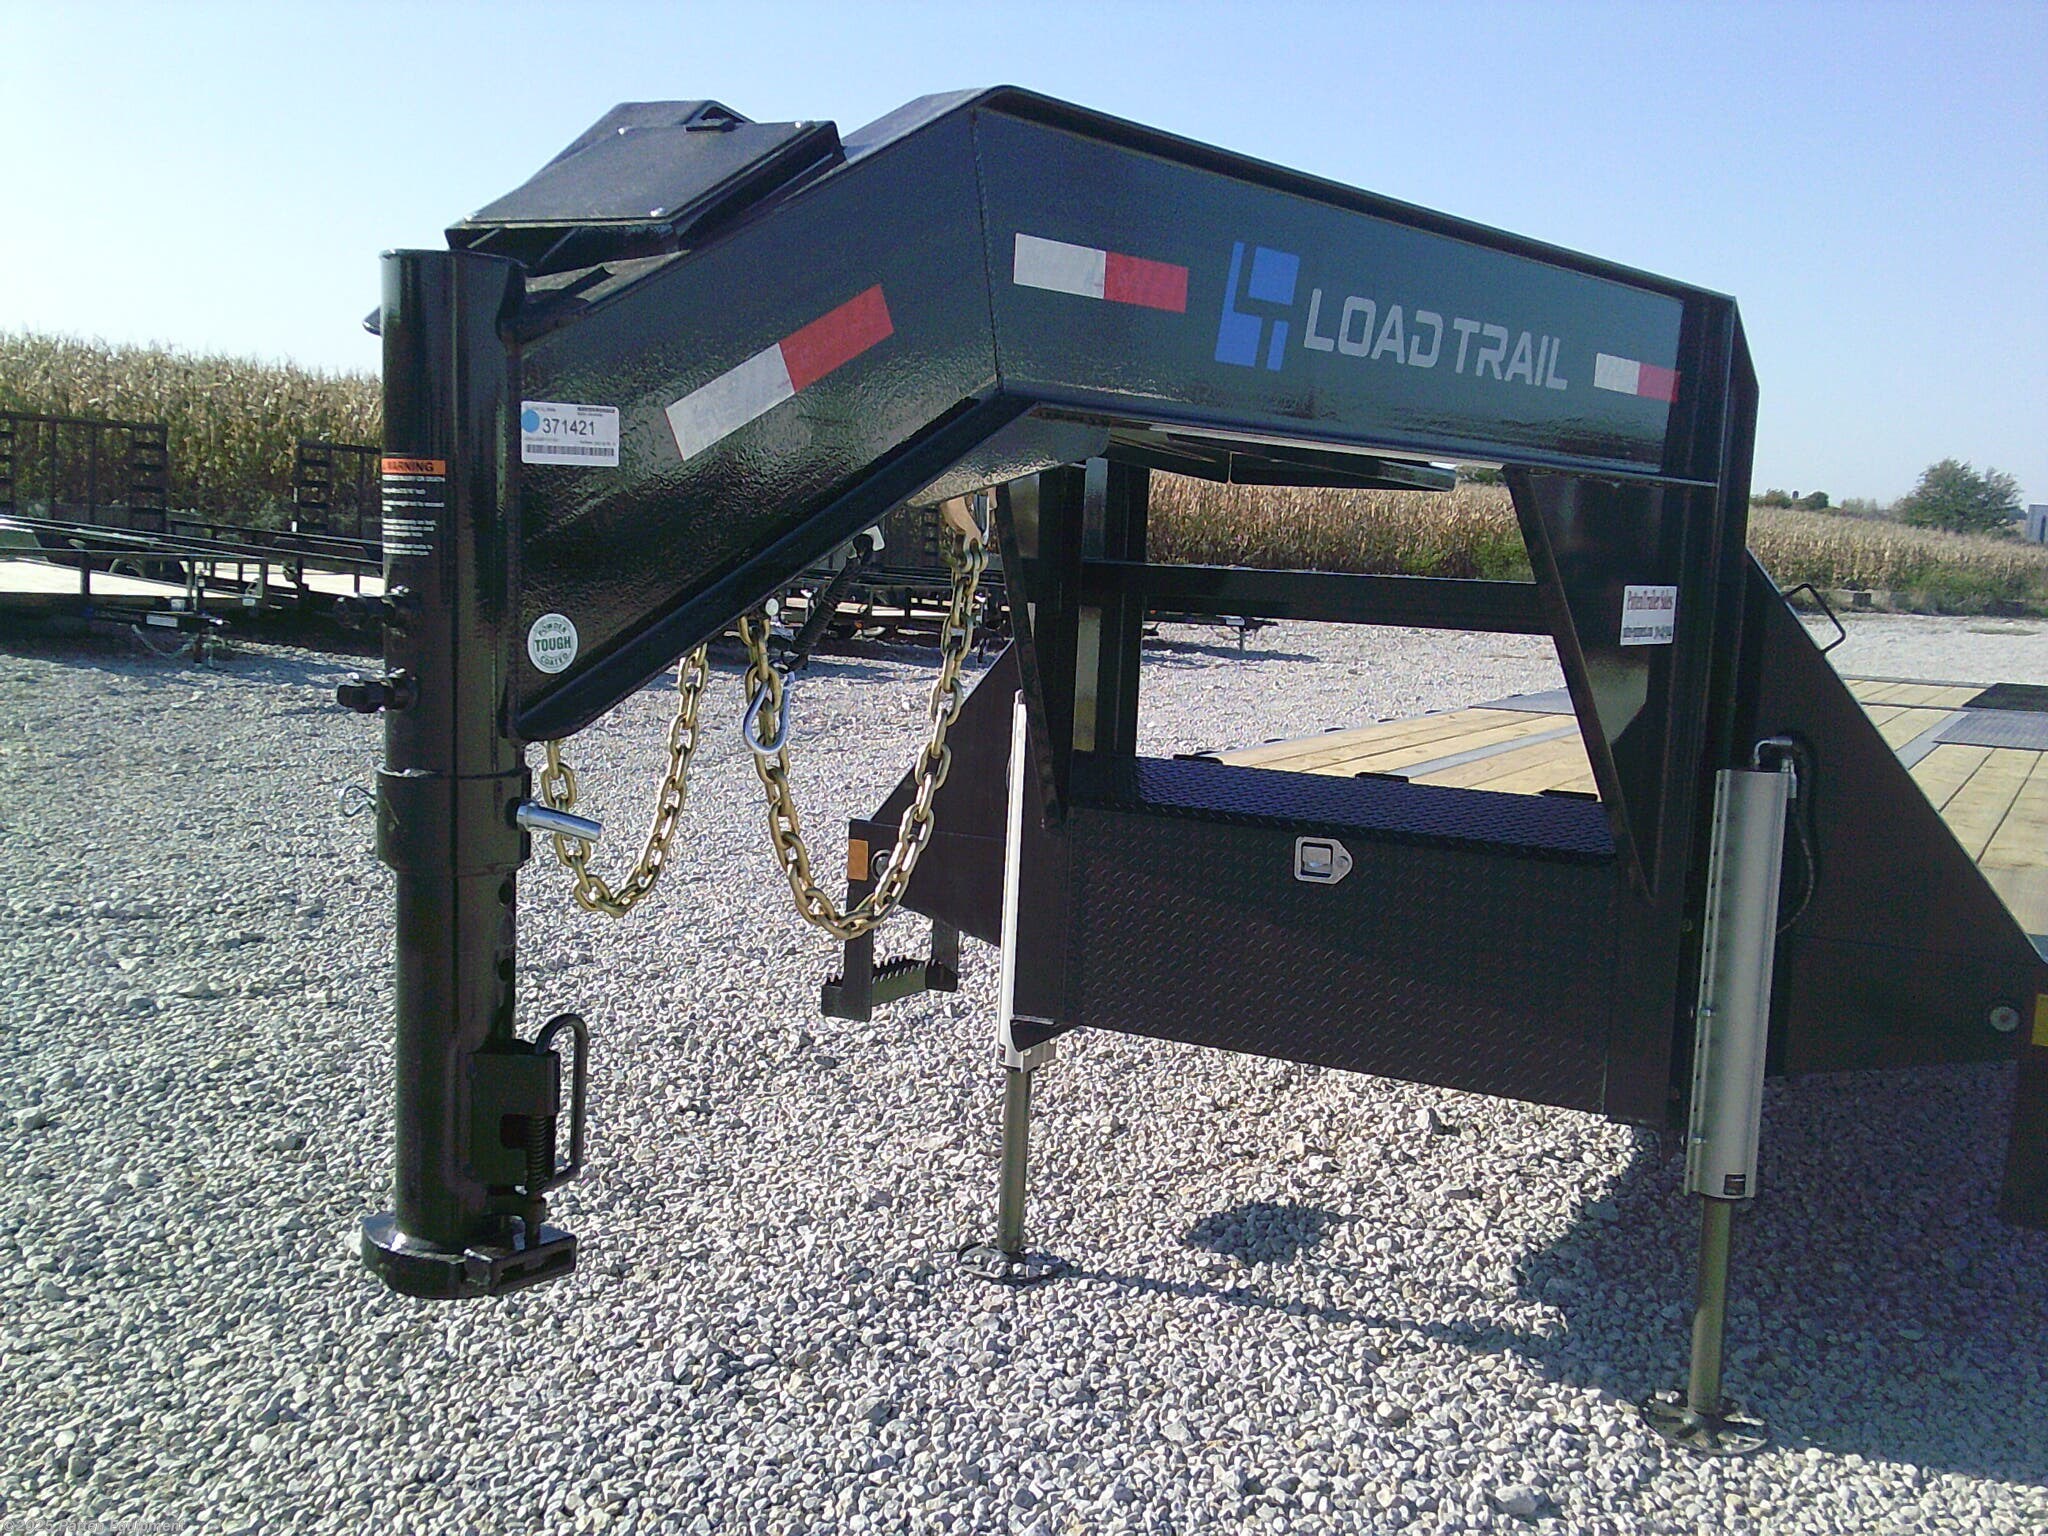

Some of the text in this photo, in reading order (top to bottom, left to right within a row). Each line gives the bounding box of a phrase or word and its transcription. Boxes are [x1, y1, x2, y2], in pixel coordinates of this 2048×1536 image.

[542, 418, 595, 436] 371421
[538, 622, 567, 636] POWDER
[535, 636, 571, 652] TOUGH
[540, 652, 569, 666] COATED
